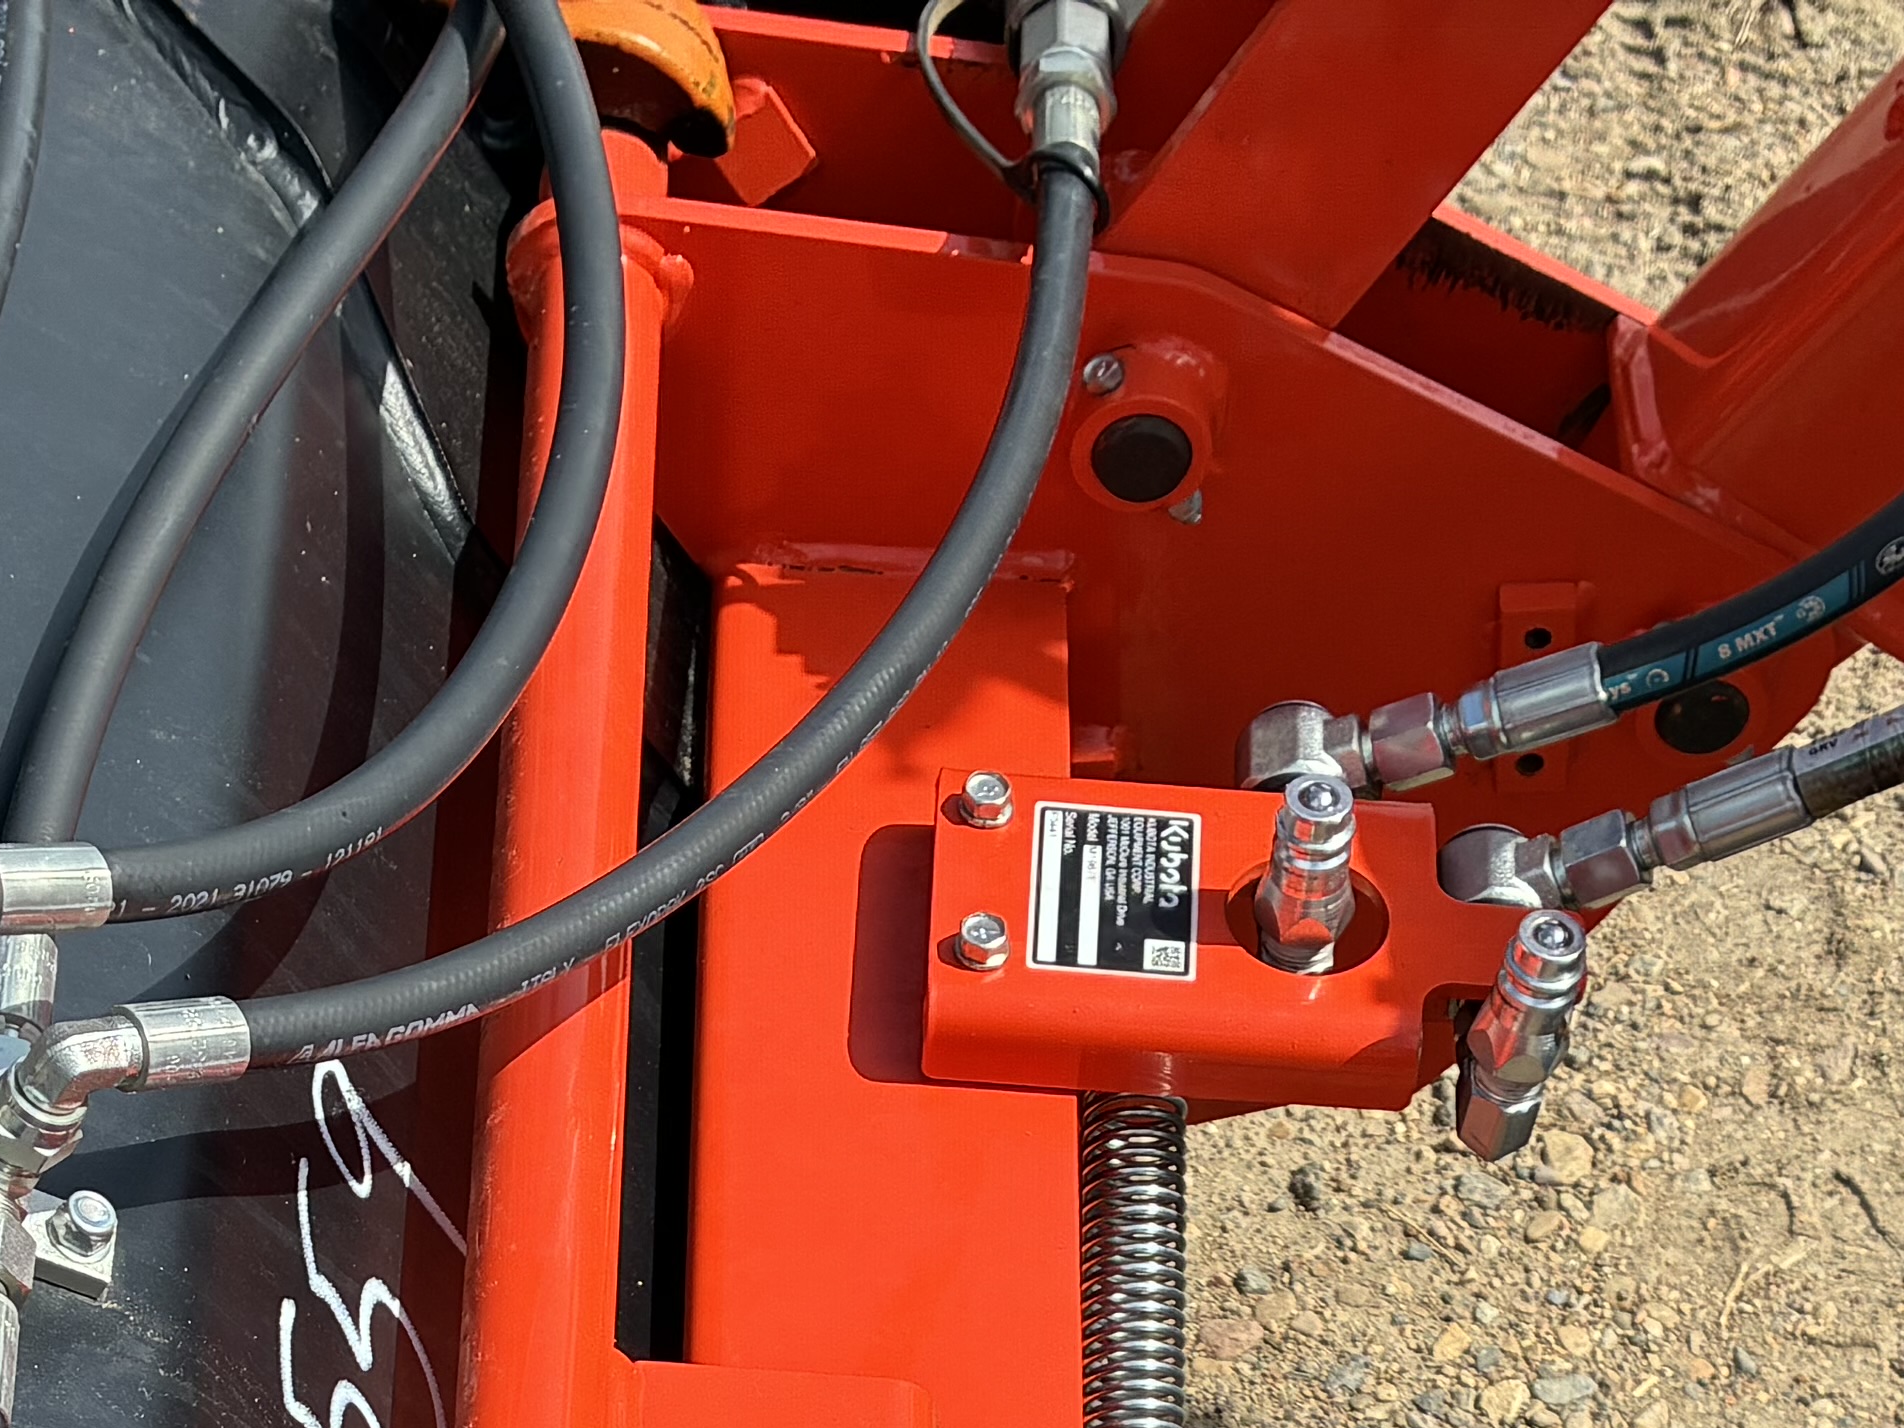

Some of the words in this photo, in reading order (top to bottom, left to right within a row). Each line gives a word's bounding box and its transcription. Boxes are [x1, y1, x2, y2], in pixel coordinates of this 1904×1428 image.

[1064, 811, 1077, 838] Serial
[1086, 813, 1100, 841] Model
[1063, 839, 1075, 855] No.
[1132, 816, 1142, 865] EQUIPMENT
[1158, 820, 1189, 908] Kubota
[1104, 883, 1115, 900] USA
[1142, 854, 1155, 904] INDUSTRIAL
